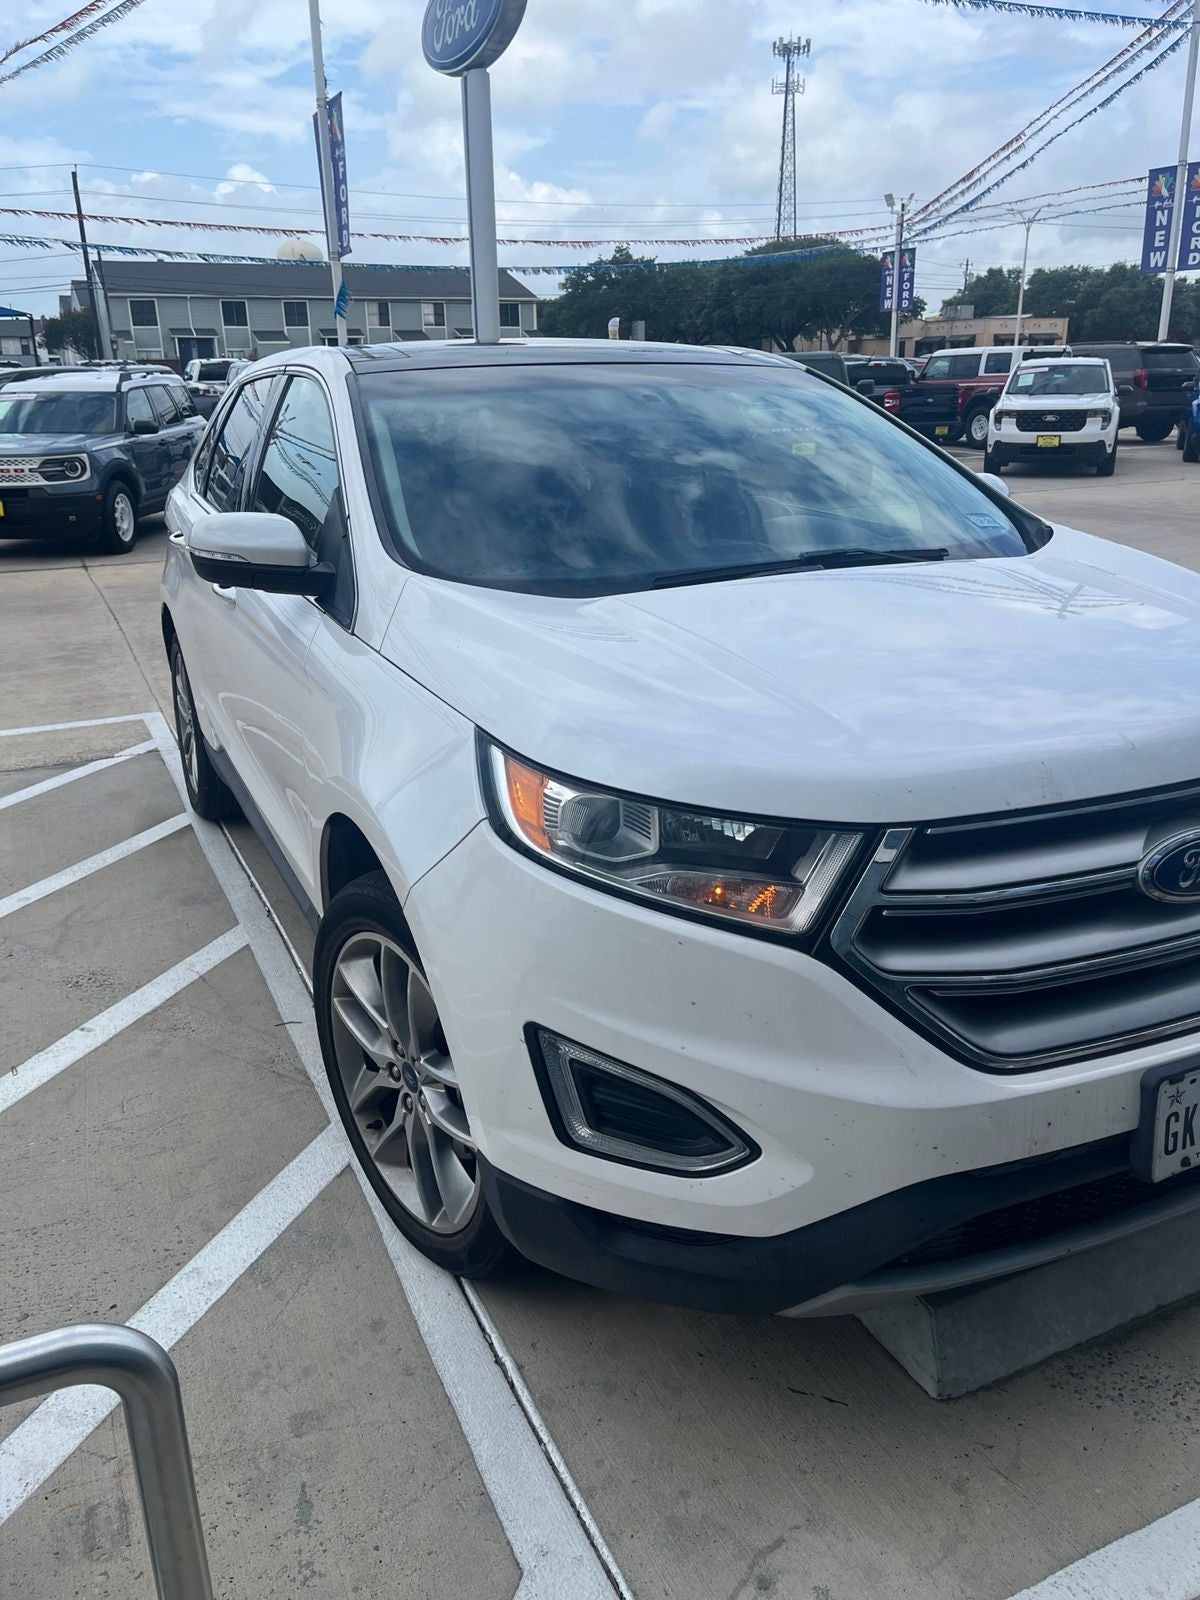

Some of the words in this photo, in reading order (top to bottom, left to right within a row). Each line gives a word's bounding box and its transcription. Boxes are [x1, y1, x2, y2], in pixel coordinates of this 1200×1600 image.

[433, 0, 480, 53] Ford
[338, 161, 349, 247] FORD
[1149, 209, 1168, 268] NEW
[884, 275, 893, 309] NEW
[902, 272, 910, 308] FORD
